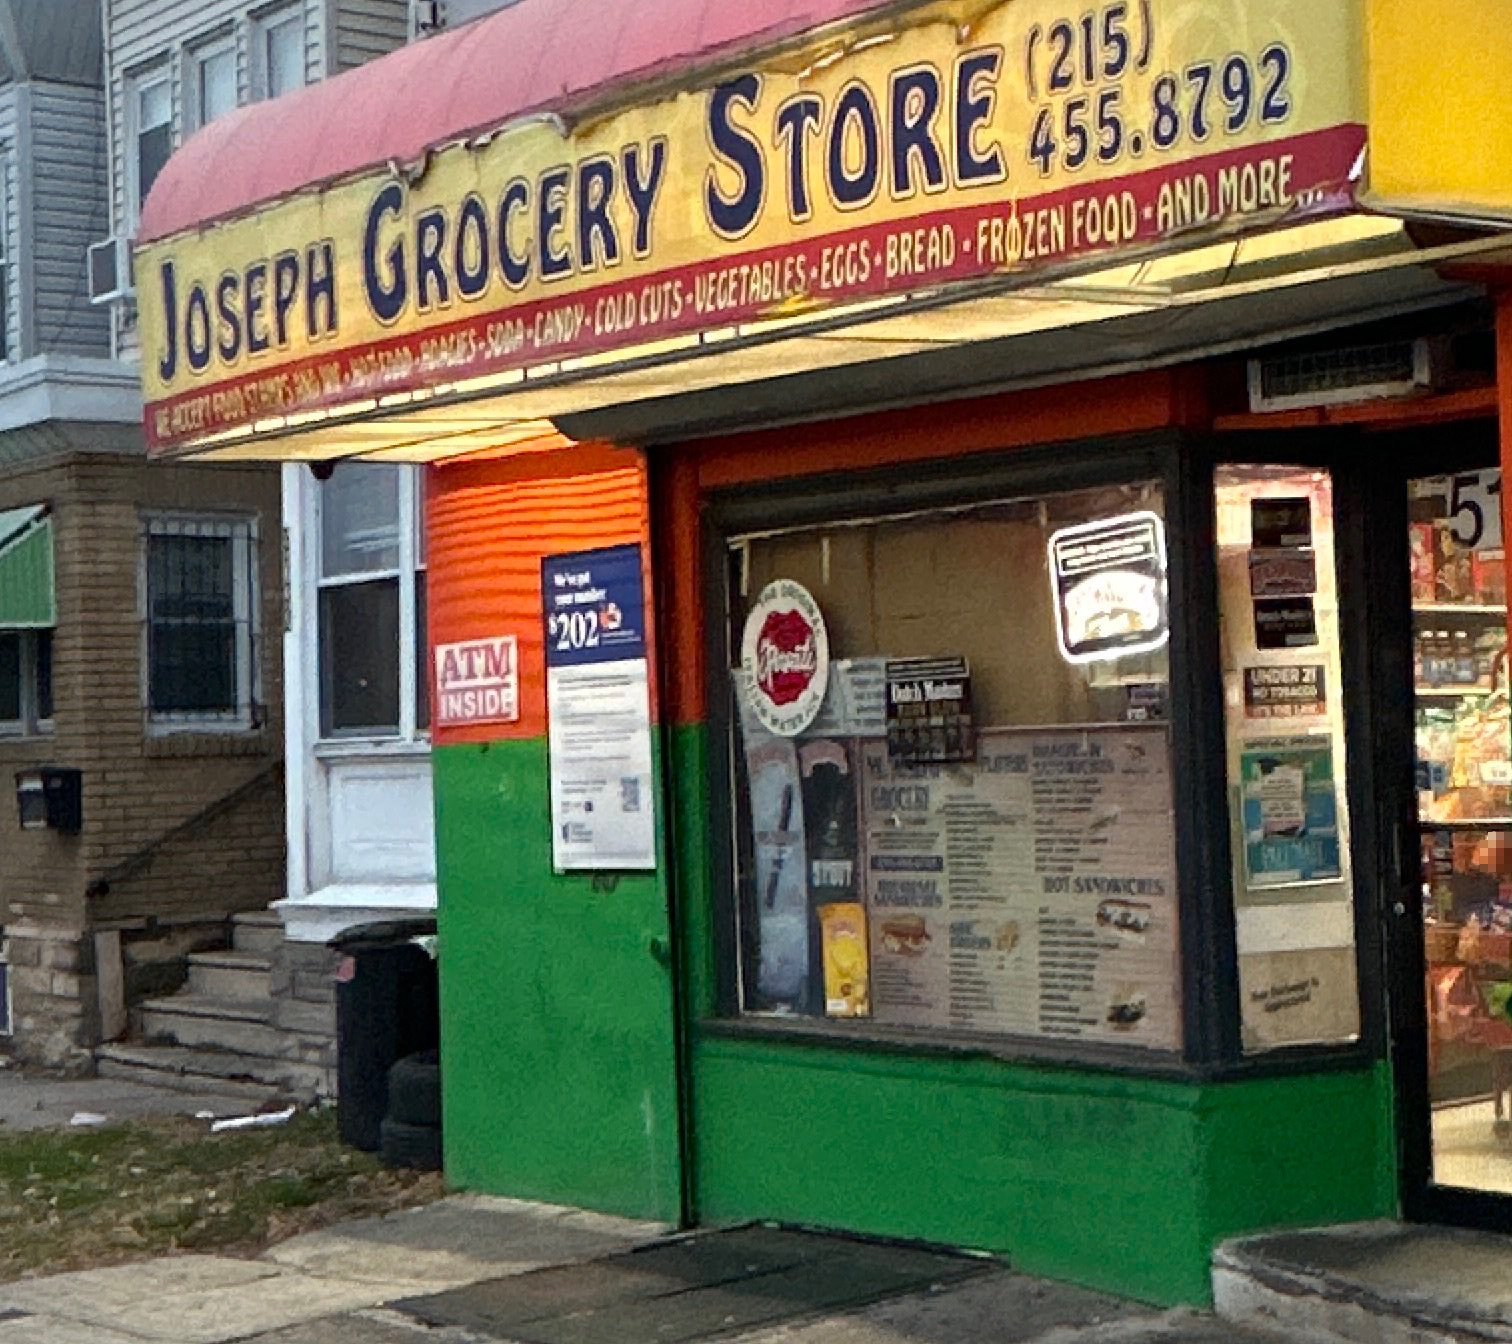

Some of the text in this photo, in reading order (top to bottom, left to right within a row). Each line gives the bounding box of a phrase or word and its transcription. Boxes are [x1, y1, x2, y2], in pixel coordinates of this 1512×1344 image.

[1027, 42, 1291, 178] 455.8792
[158, 46, 1007, 384] JOSEPH GROCERY STORE
[533, 304, 585, 349] CANDY
[594, 296, 634, 337] COLD
[638, 280, 682, 327] CUTS
[694, 253, 808, 313] VEGETABLES
[819, 239, 871, 290] EGGS
[885, 224, 955, 278] BREAD
[975, 207, 1066, 265] FROZEN
[1071, 195, 1136, 245] FOOD
[1156, 174, 1210, 232] AND
[440, 642, 512, 685] ATM
[440, 689, 513, 720] INSIDE
